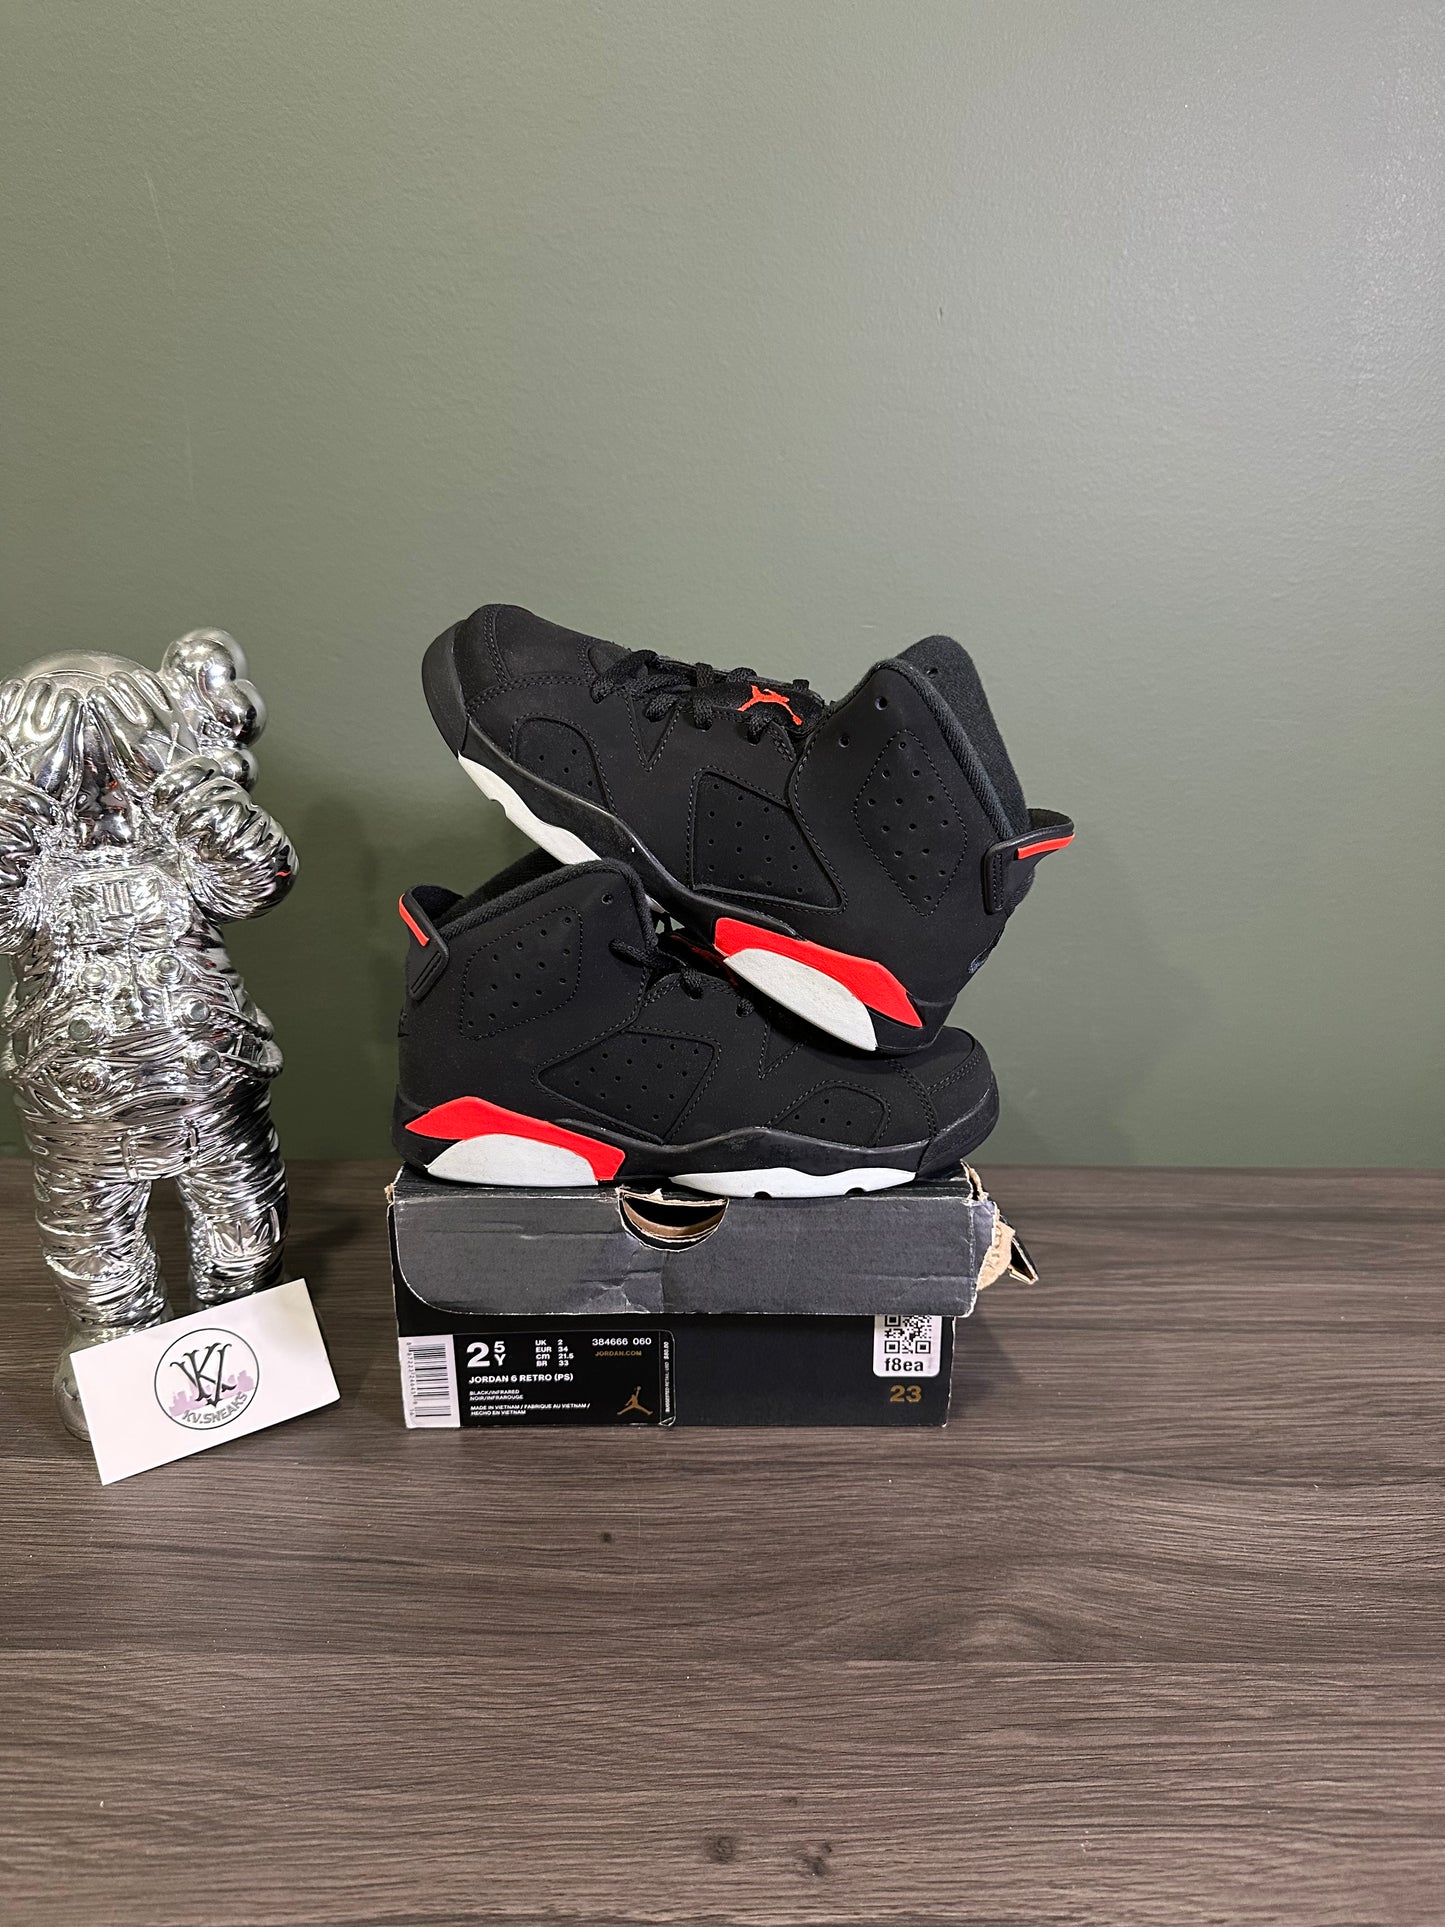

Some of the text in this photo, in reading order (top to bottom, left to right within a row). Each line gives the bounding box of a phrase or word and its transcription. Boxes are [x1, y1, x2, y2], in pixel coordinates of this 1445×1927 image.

[592, 1338, 628, 1346] 384666
[467, 1341, 505, 1368] 2 5
[494, 1354, 506, 1366] Y
[884, 1358, 924, 1372] f8ea
[468, 1376, 508, 1384] JORDAN
[520, 1374, 552, 1382] RETRO
[554, 1373, 574, 1382] (PS)
[890, 1384, 922, 1403] 23
[182, 1392, 248, 1424] KV.SNEAKS
